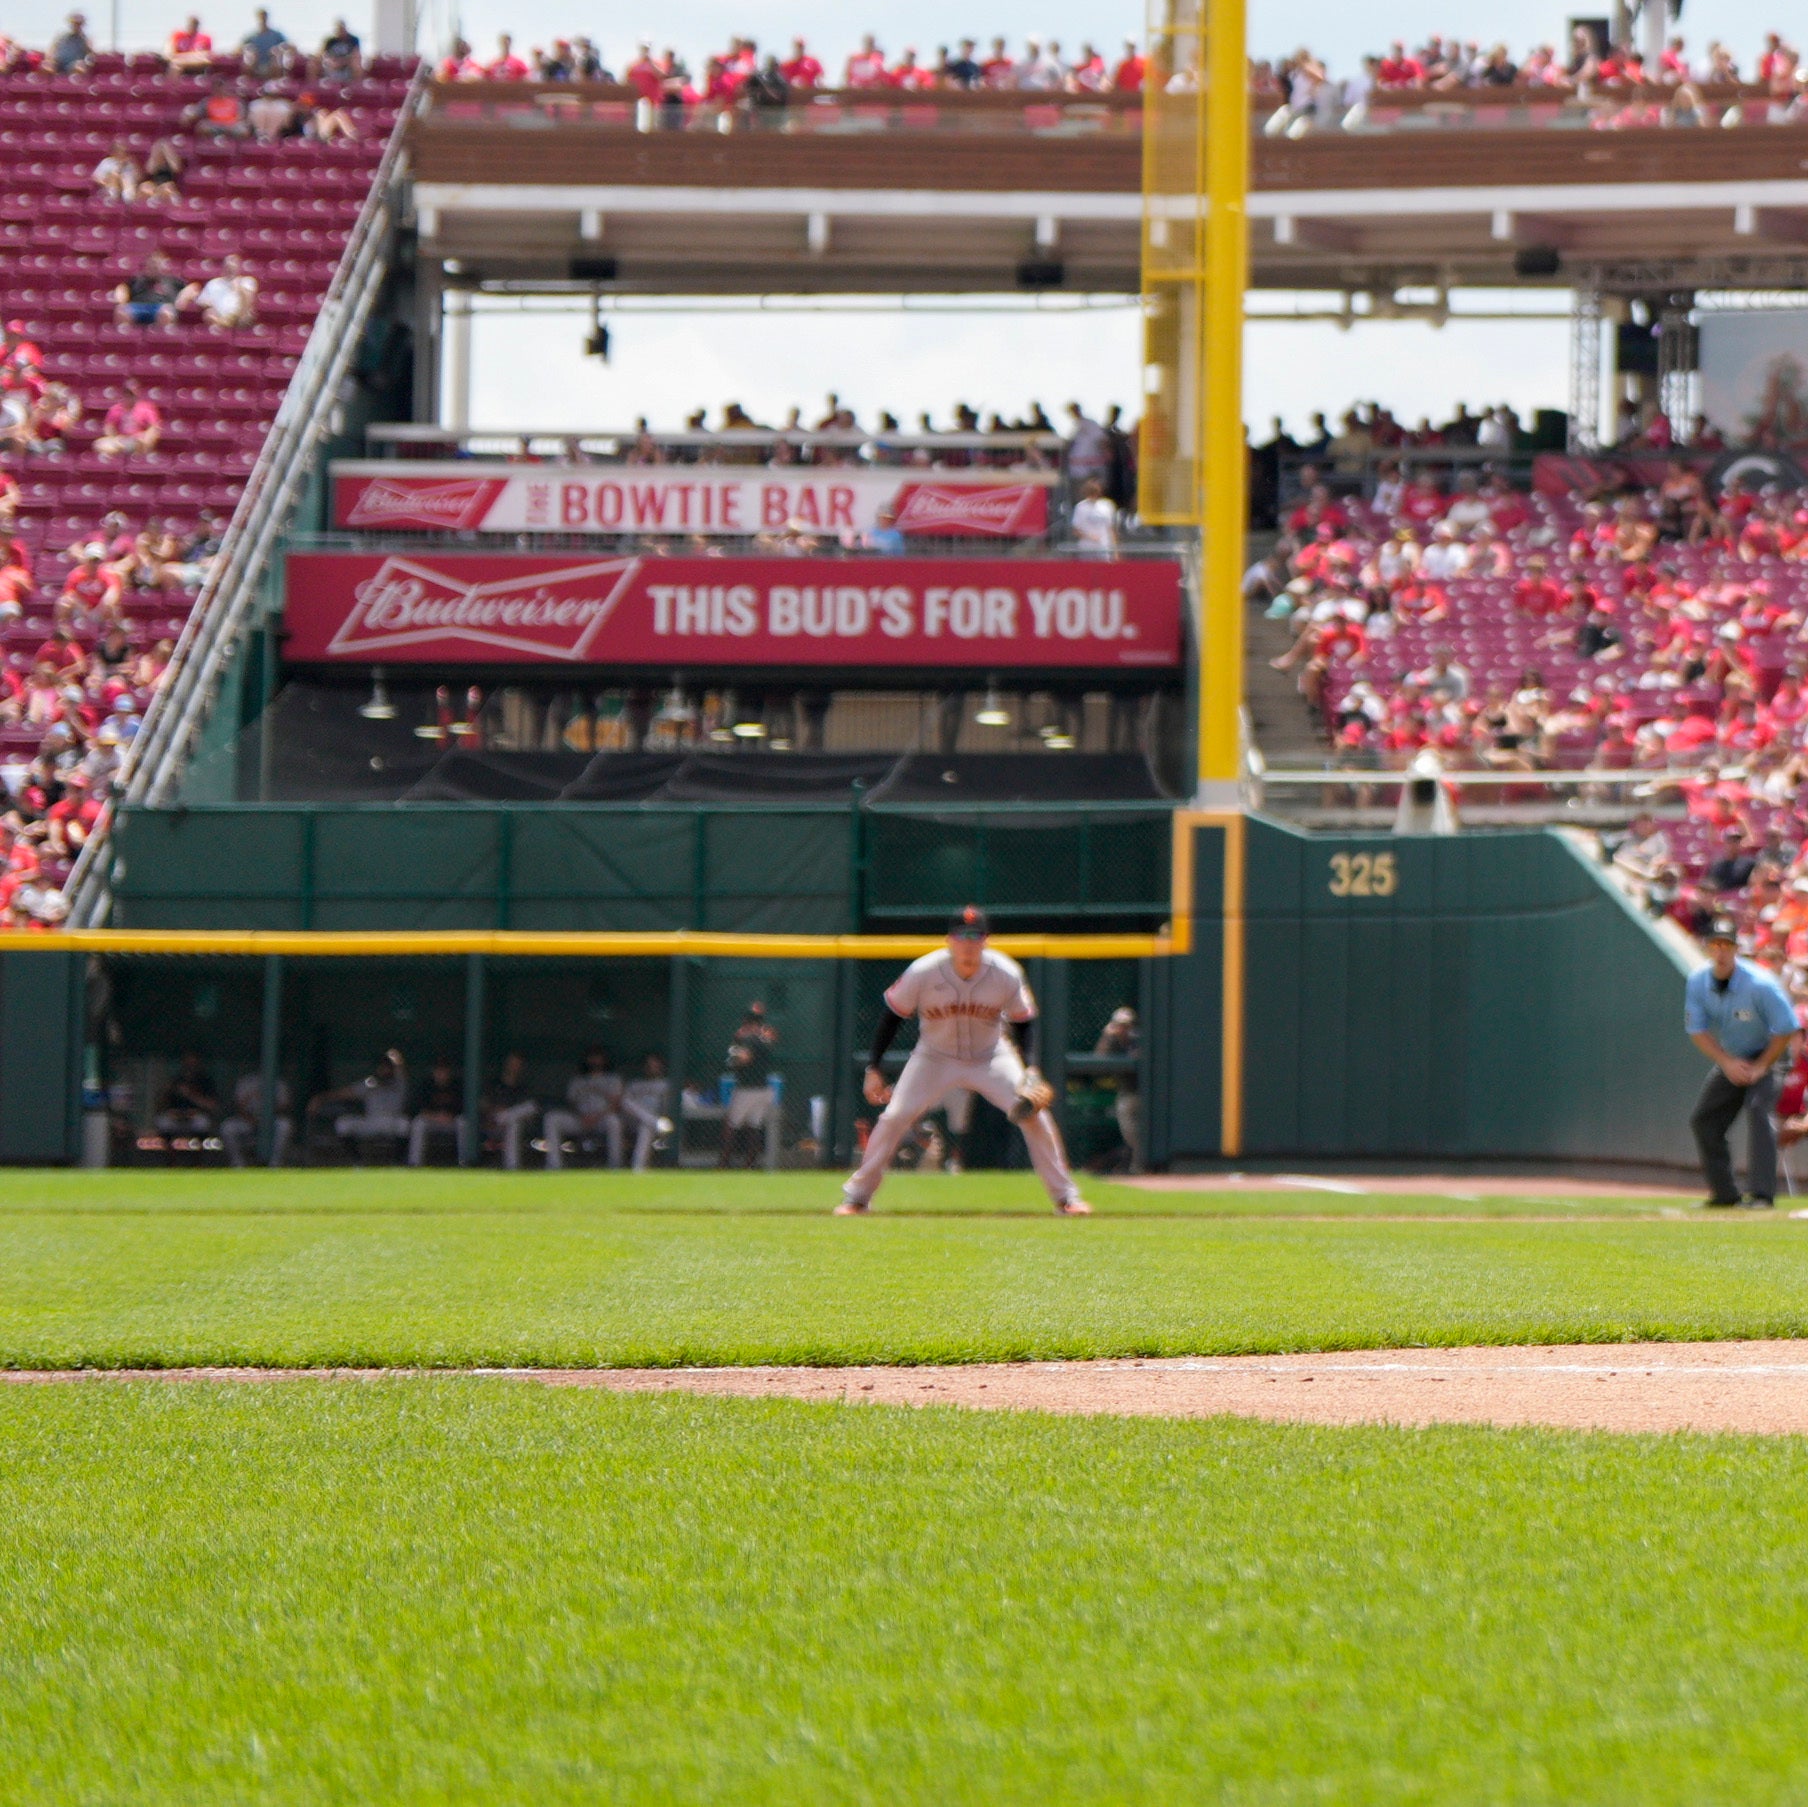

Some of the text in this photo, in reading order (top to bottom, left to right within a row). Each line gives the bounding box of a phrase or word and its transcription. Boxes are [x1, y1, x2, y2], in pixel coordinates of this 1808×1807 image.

[561, 483, 742, 527] BOWTIE
[761, 484, 856, 529] BAR
[355, 578, 607, 630] Budweiser
[647, 585, 1140, 640] THIS BUD'S FOR YOU.
[1328, 850, 1398, 898] 325
